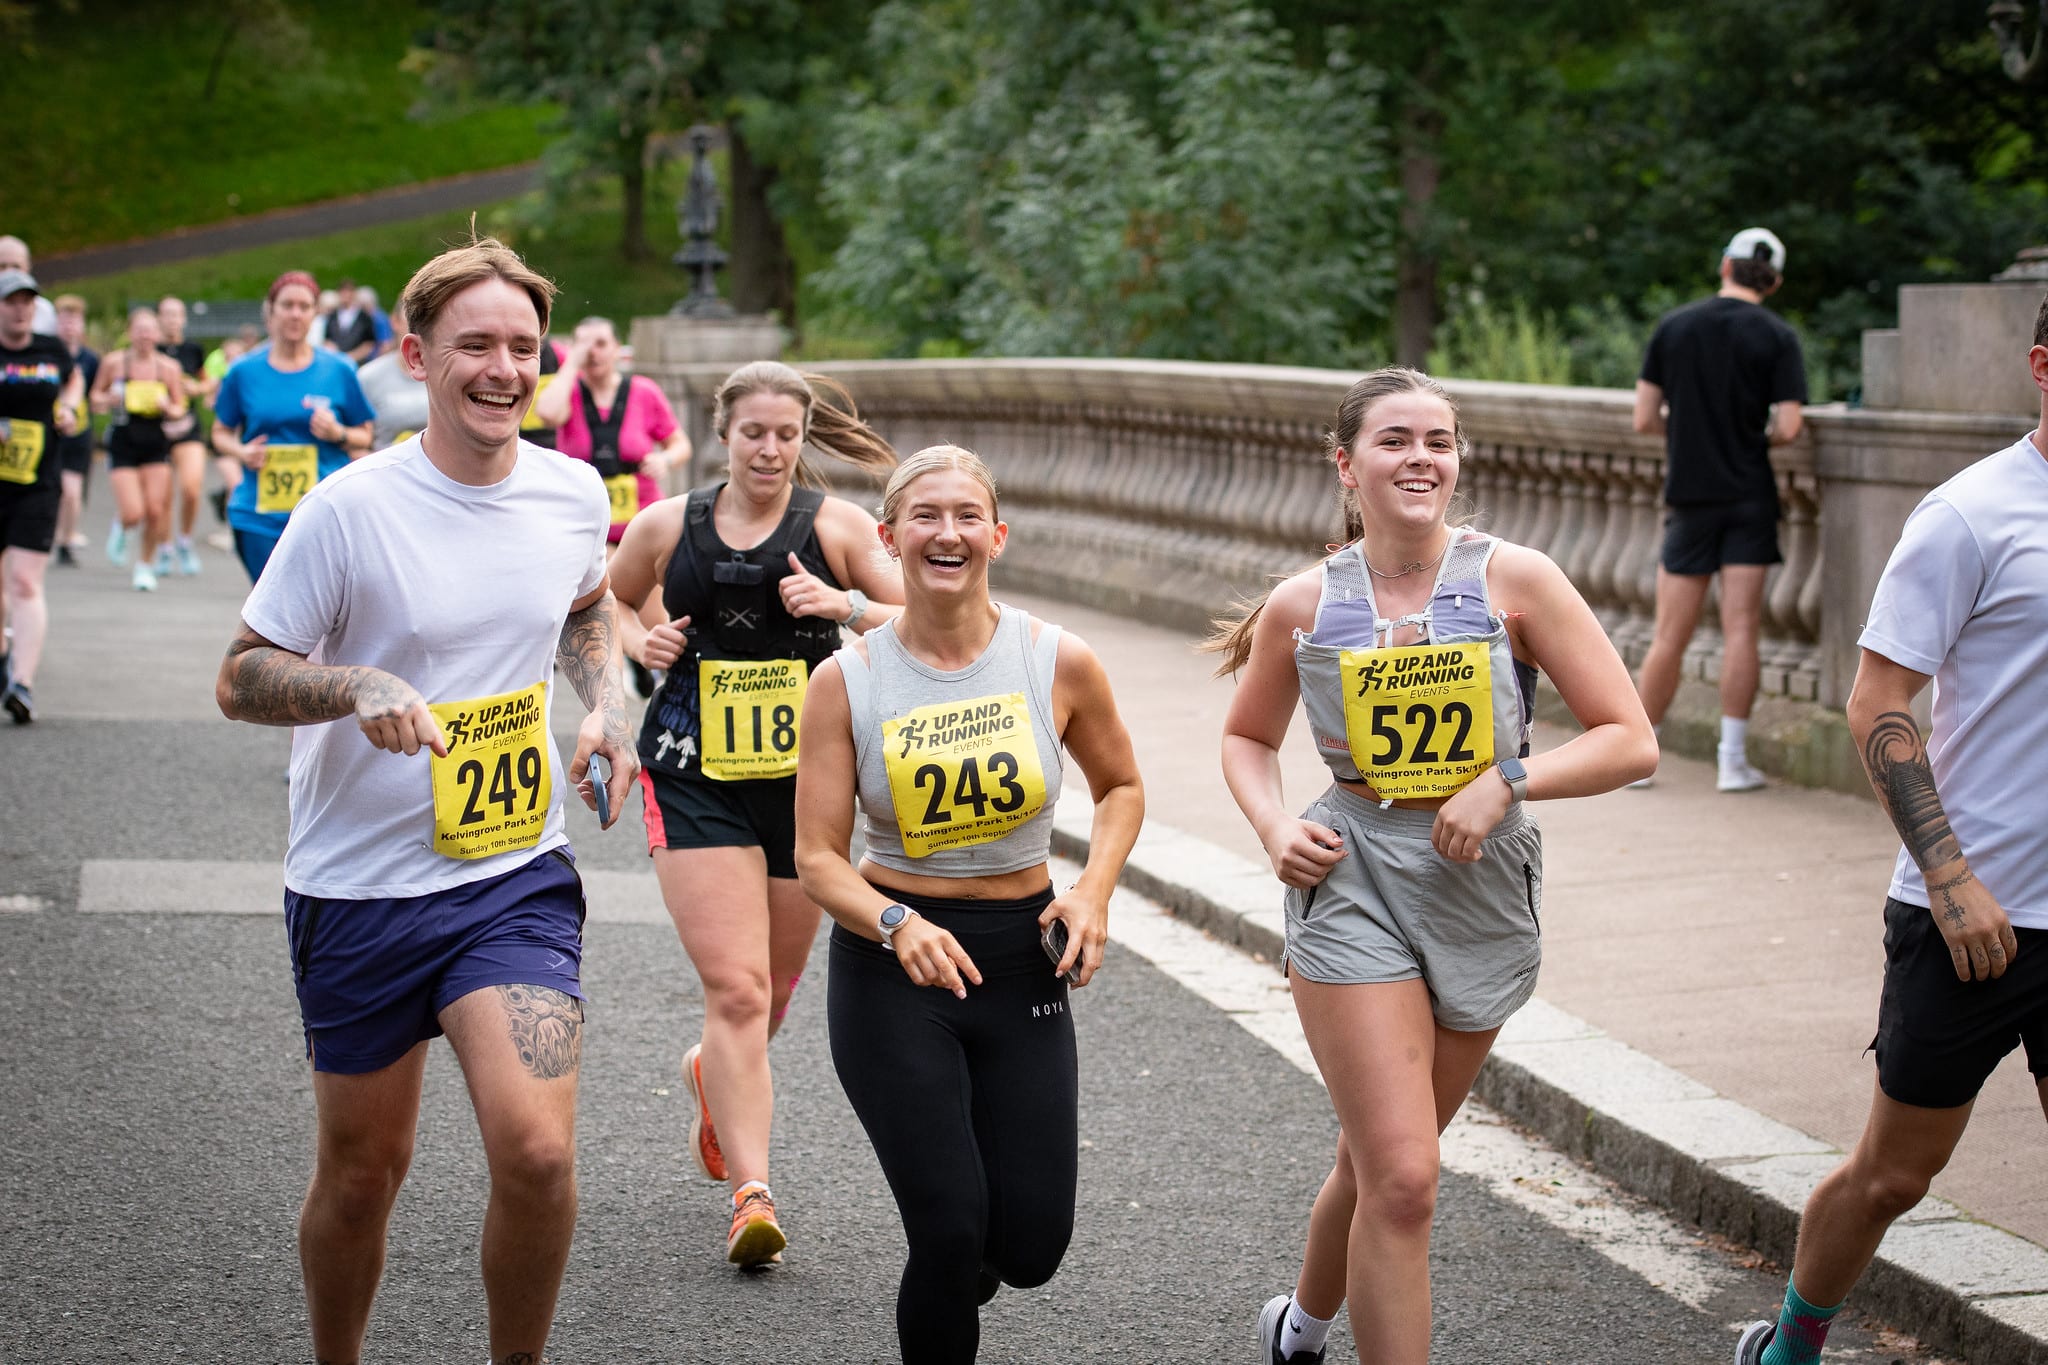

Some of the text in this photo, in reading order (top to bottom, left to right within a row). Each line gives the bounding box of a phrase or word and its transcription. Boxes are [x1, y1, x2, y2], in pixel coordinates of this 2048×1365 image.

[264, 471, 309, 496] 392
[1392, 650, 1463, 673] UP AND
[738, 666, 789, 680] UP AND
[1385, 665, 1475, 690] RUNNING
[732, 677, 797, 693] RUNNING
[749, 691, 780, 701] EVENTS
[1410, 685, 1450, 699] EVENTS
[478, 694, 535, 724] UP AND
[932, 702, 1002, 731] UP AND
[472, 707, 540, 743] RUNNING
[724, 704, 797, 754] 118
[928, 715, 1015, 748] RUNNING
[1371, 701, 1475, 766] 522
[493, 731, 527, 749] EVENTS
[953, 737, 993, 754] EVENTS
[705, 757, 756, 765] Kelvingrove
[1426, 765, 1453, 776] Park
[457, 746, 542, 826] 249
[914, 751, 1026, 825] 243
[1376, 786, 1409, 795] Sunday
[1411, 783, 1429, 792] 10th
[441, 825, 502, 841] Kelvingrove
[504, 818, 527, 830] Park
[905, 823, 973, 839] Kelvingrove
[975, 817, 1004, 828] Park
[460, 844, 489, 855] Sunday
[491, 837, 506, 848] 10th
[927, 837, 960, 850] Sunday
[962, 833, 981, 842] 10th
